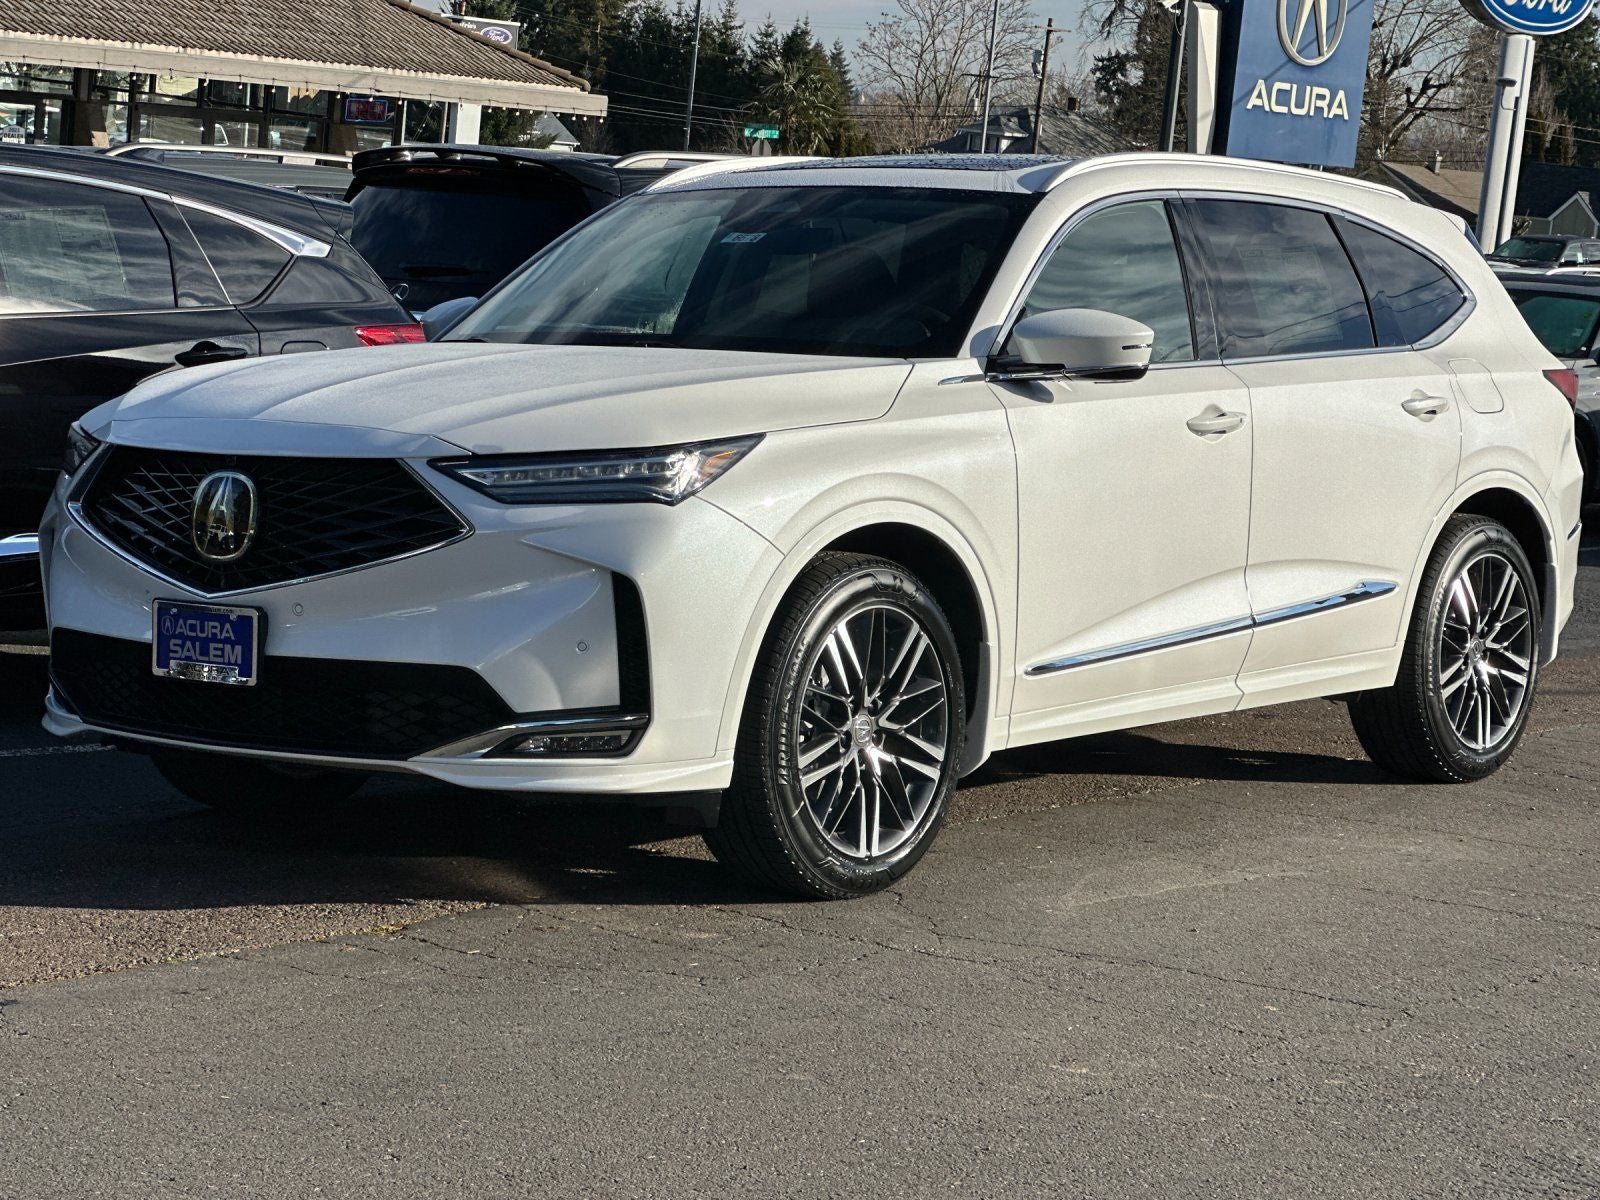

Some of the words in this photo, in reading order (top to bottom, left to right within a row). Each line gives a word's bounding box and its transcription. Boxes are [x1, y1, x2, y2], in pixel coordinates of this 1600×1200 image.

[486, 29, 506, 42] Ford
[1246, 79, 1349, 120] ACURA
[176, 618, 235, 640] ACURA
[169, 639, 242, 664] SALEM
